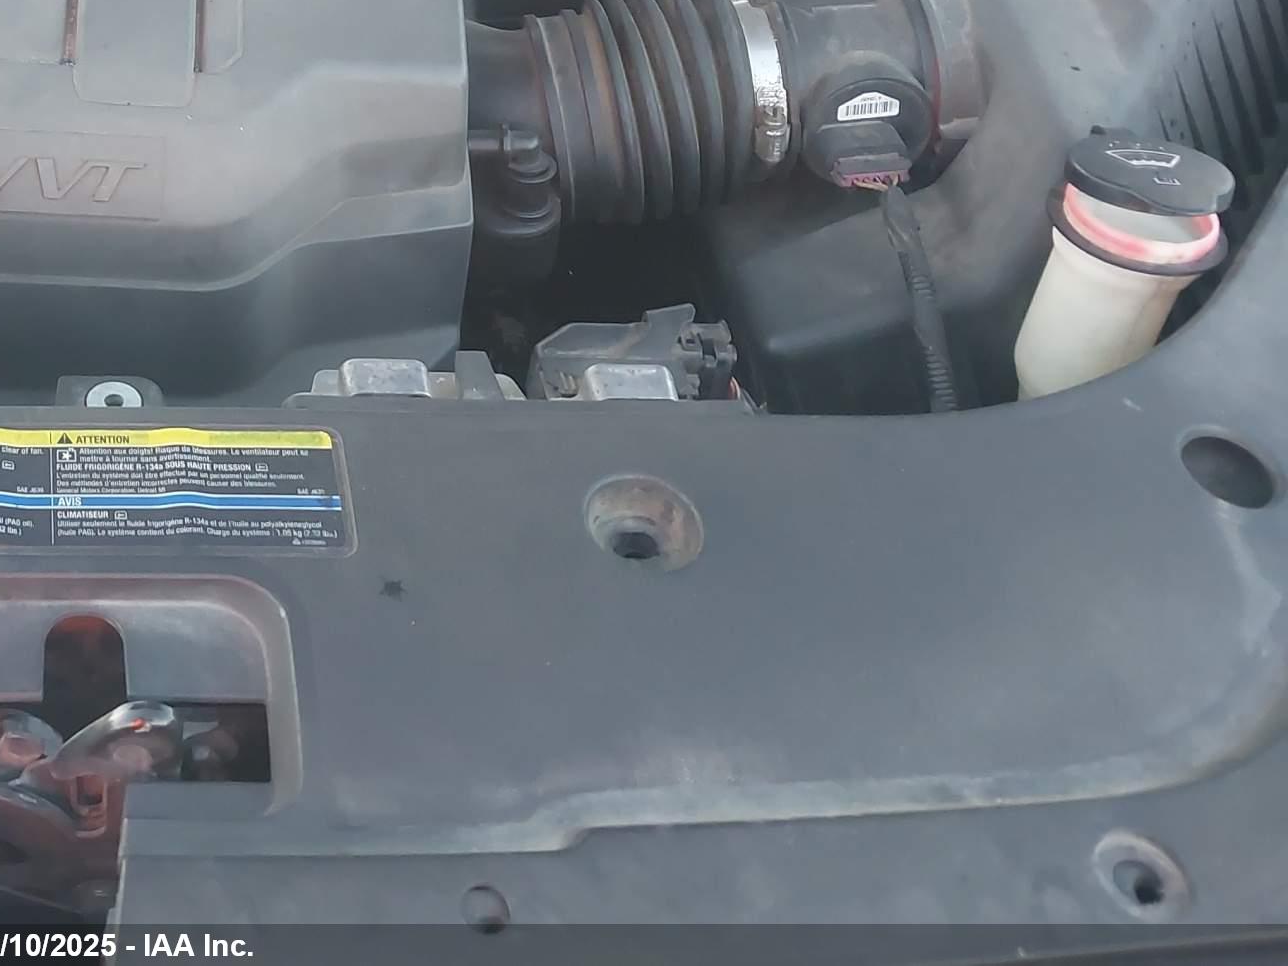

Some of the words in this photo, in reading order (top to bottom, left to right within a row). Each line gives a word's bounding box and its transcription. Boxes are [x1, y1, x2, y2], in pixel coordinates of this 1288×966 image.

[187, 462, 211, 471] HAUTE
[58, 497, 81, 506] AVIS
[5, 518, 20, 526] (PAG
[185, 517, 208, 525] R-134a
